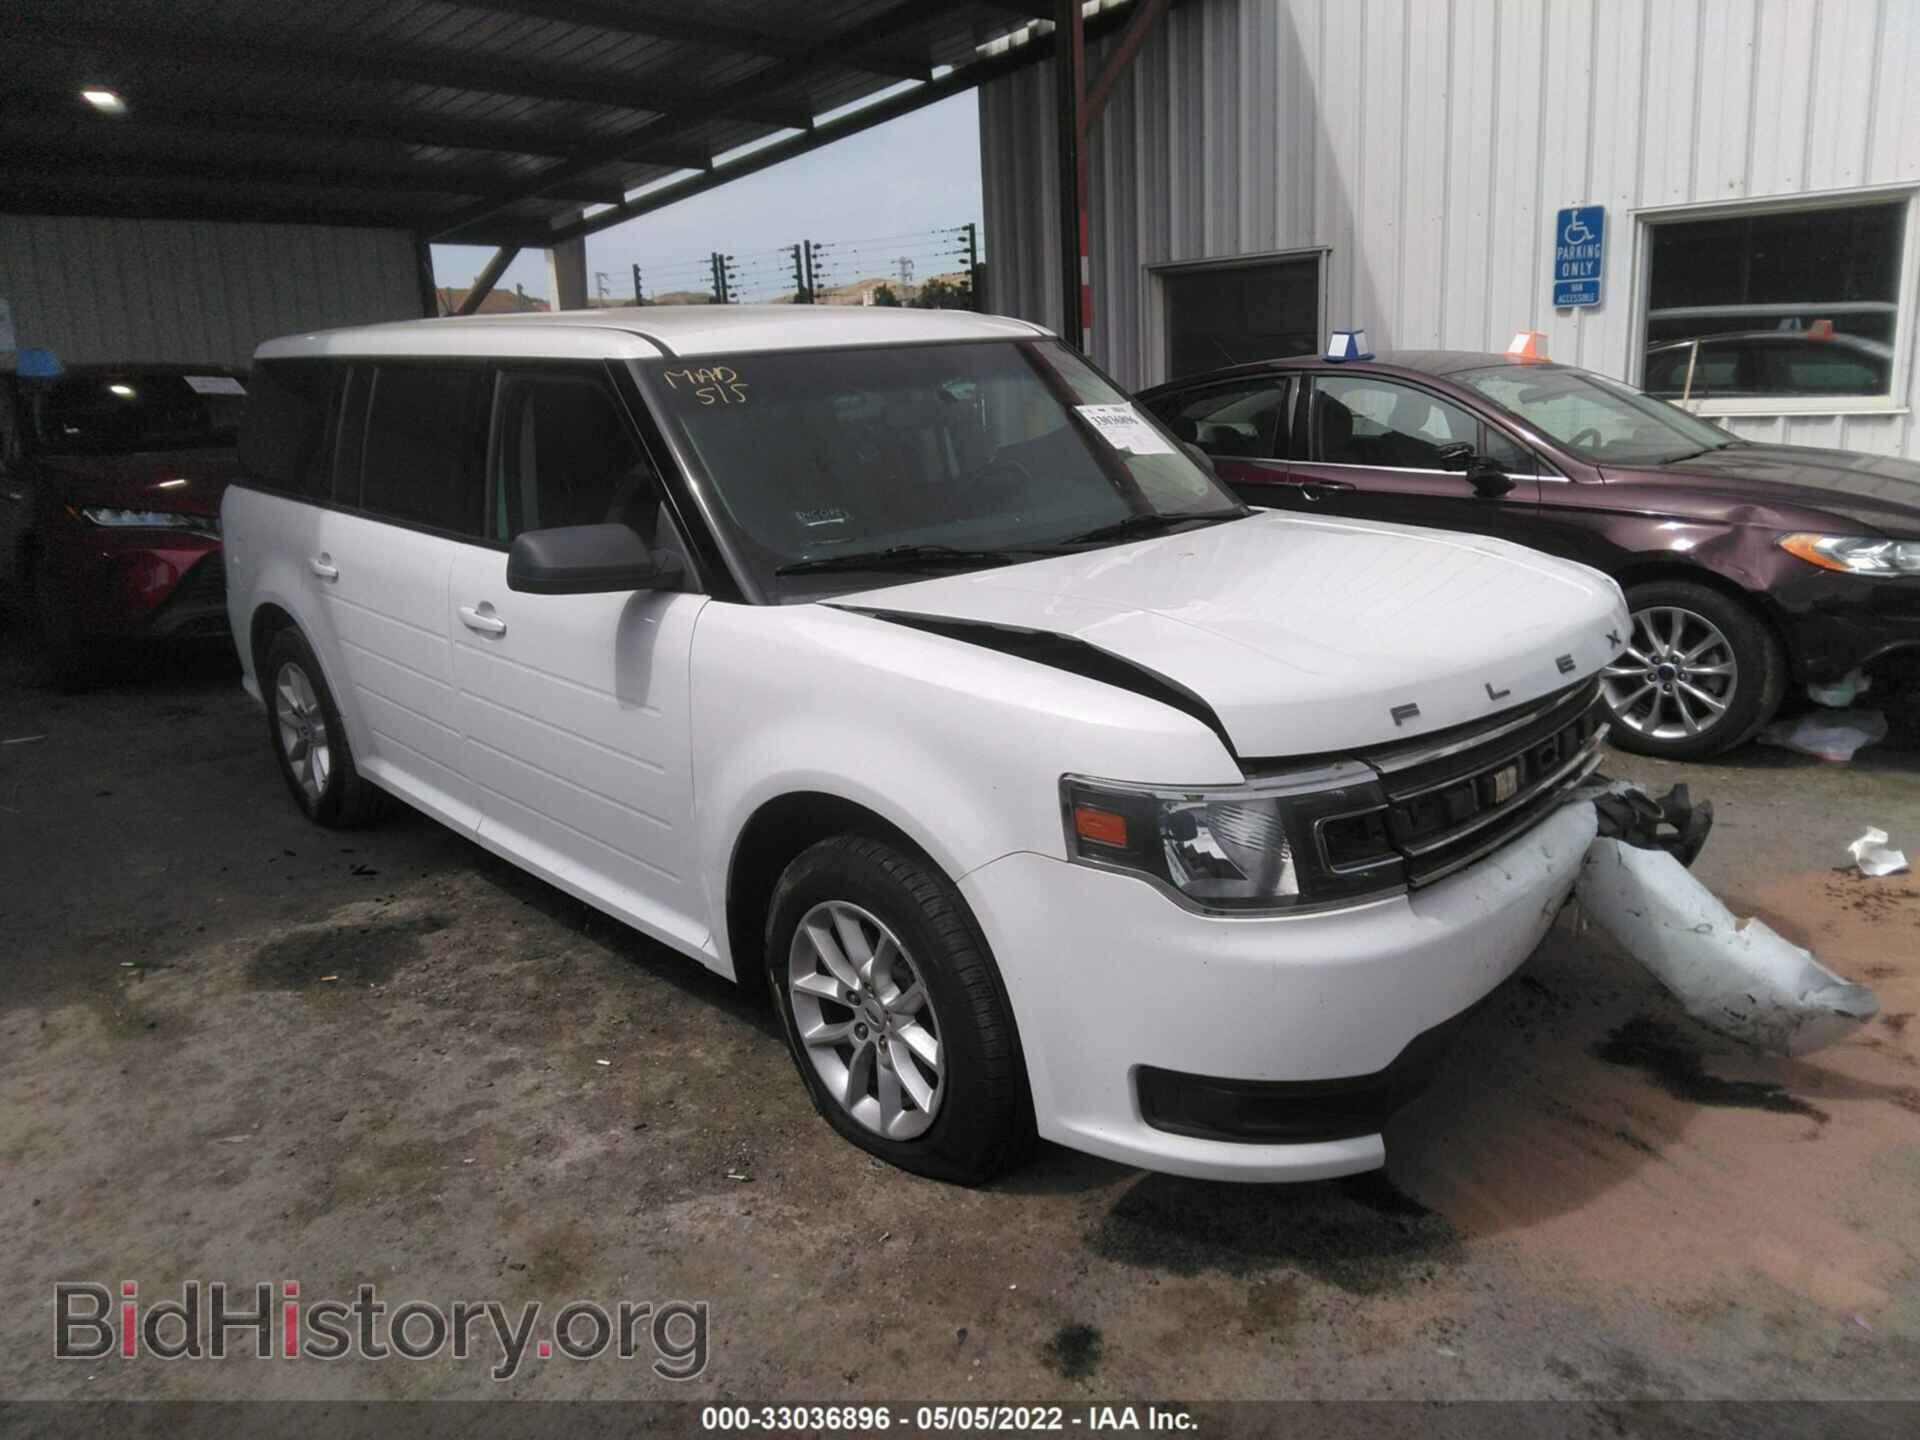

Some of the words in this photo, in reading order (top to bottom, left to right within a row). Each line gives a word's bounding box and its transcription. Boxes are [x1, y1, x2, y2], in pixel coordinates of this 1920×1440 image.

[1557, 244, 1601, 260] PARKING
[1562, 261, 1594, 277] ONLY
[1389, 629, 1622, 727] FLEX
